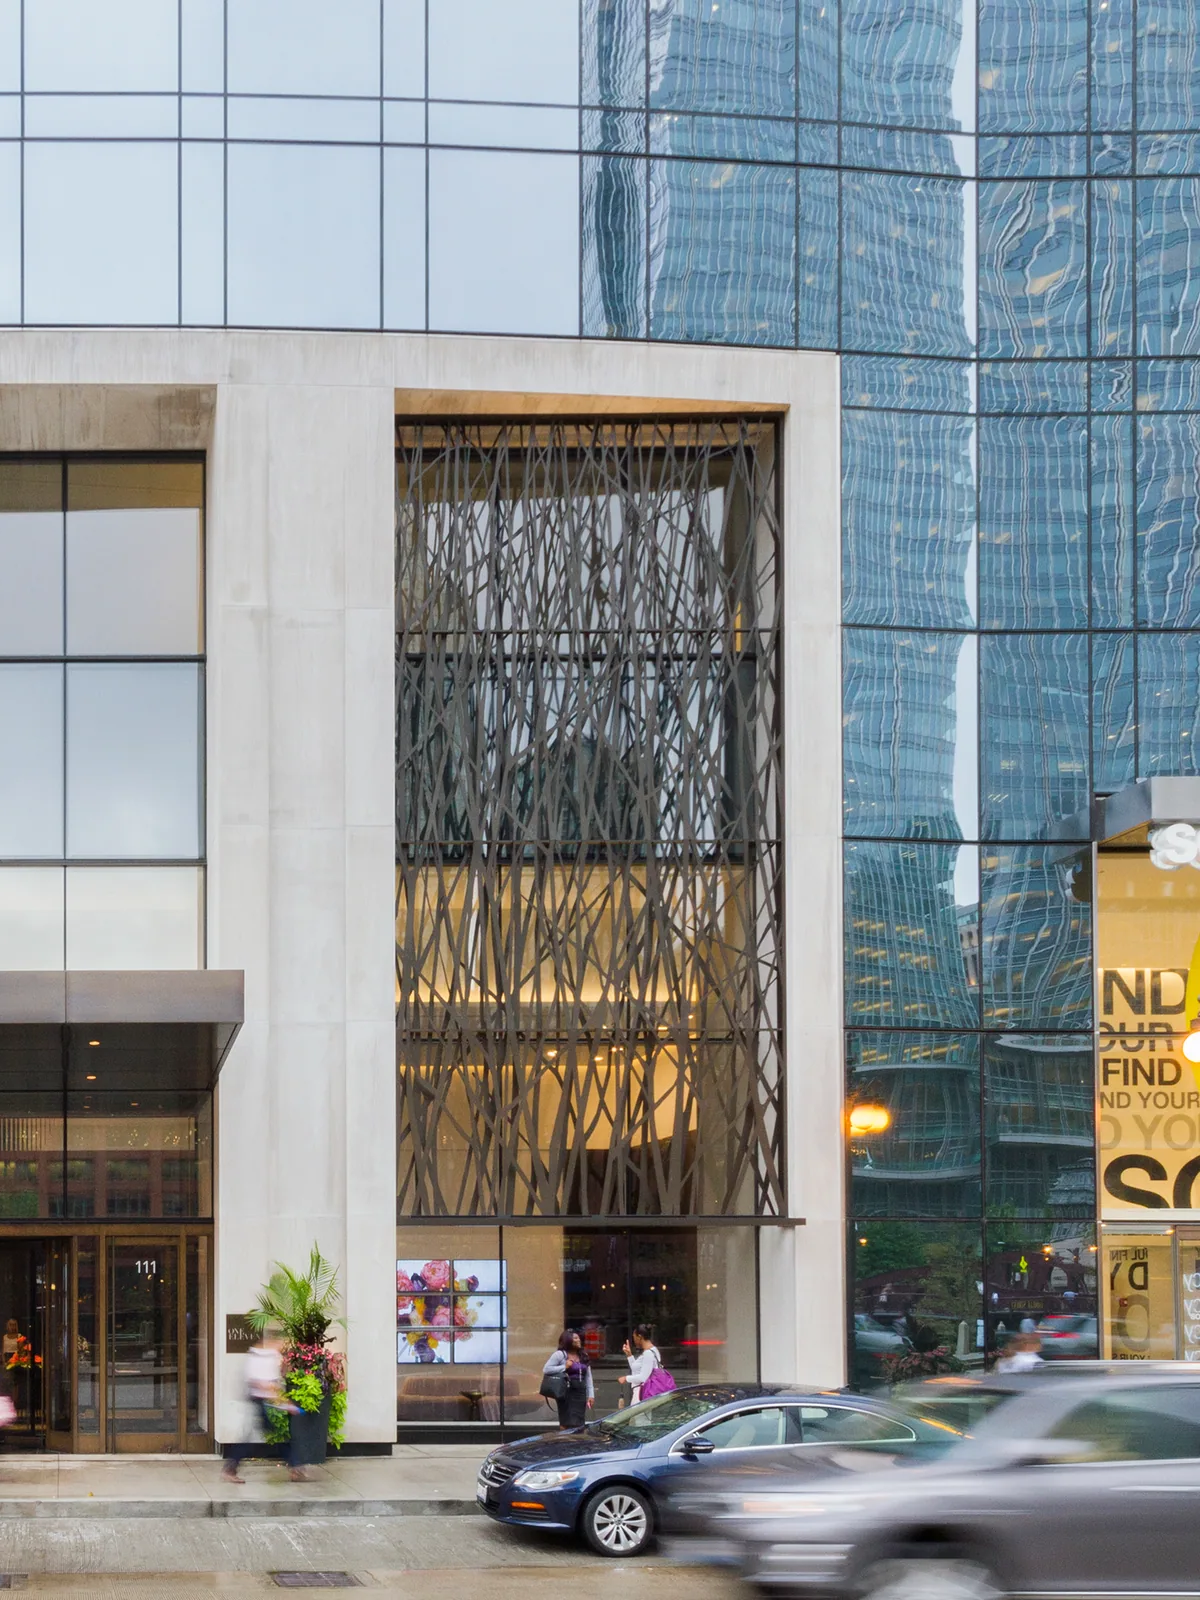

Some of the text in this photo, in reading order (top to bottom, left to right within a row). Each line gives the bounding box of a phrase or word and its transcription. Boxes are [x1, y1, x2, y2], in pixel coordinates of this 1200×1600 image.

[1102, 1058, 1182, 1086] FIND
[1138, 1091, 1200, 1109] YOUR
[1133, 1114, 1200, 1151] YO
[135, 1260, 157, 1274] 111
